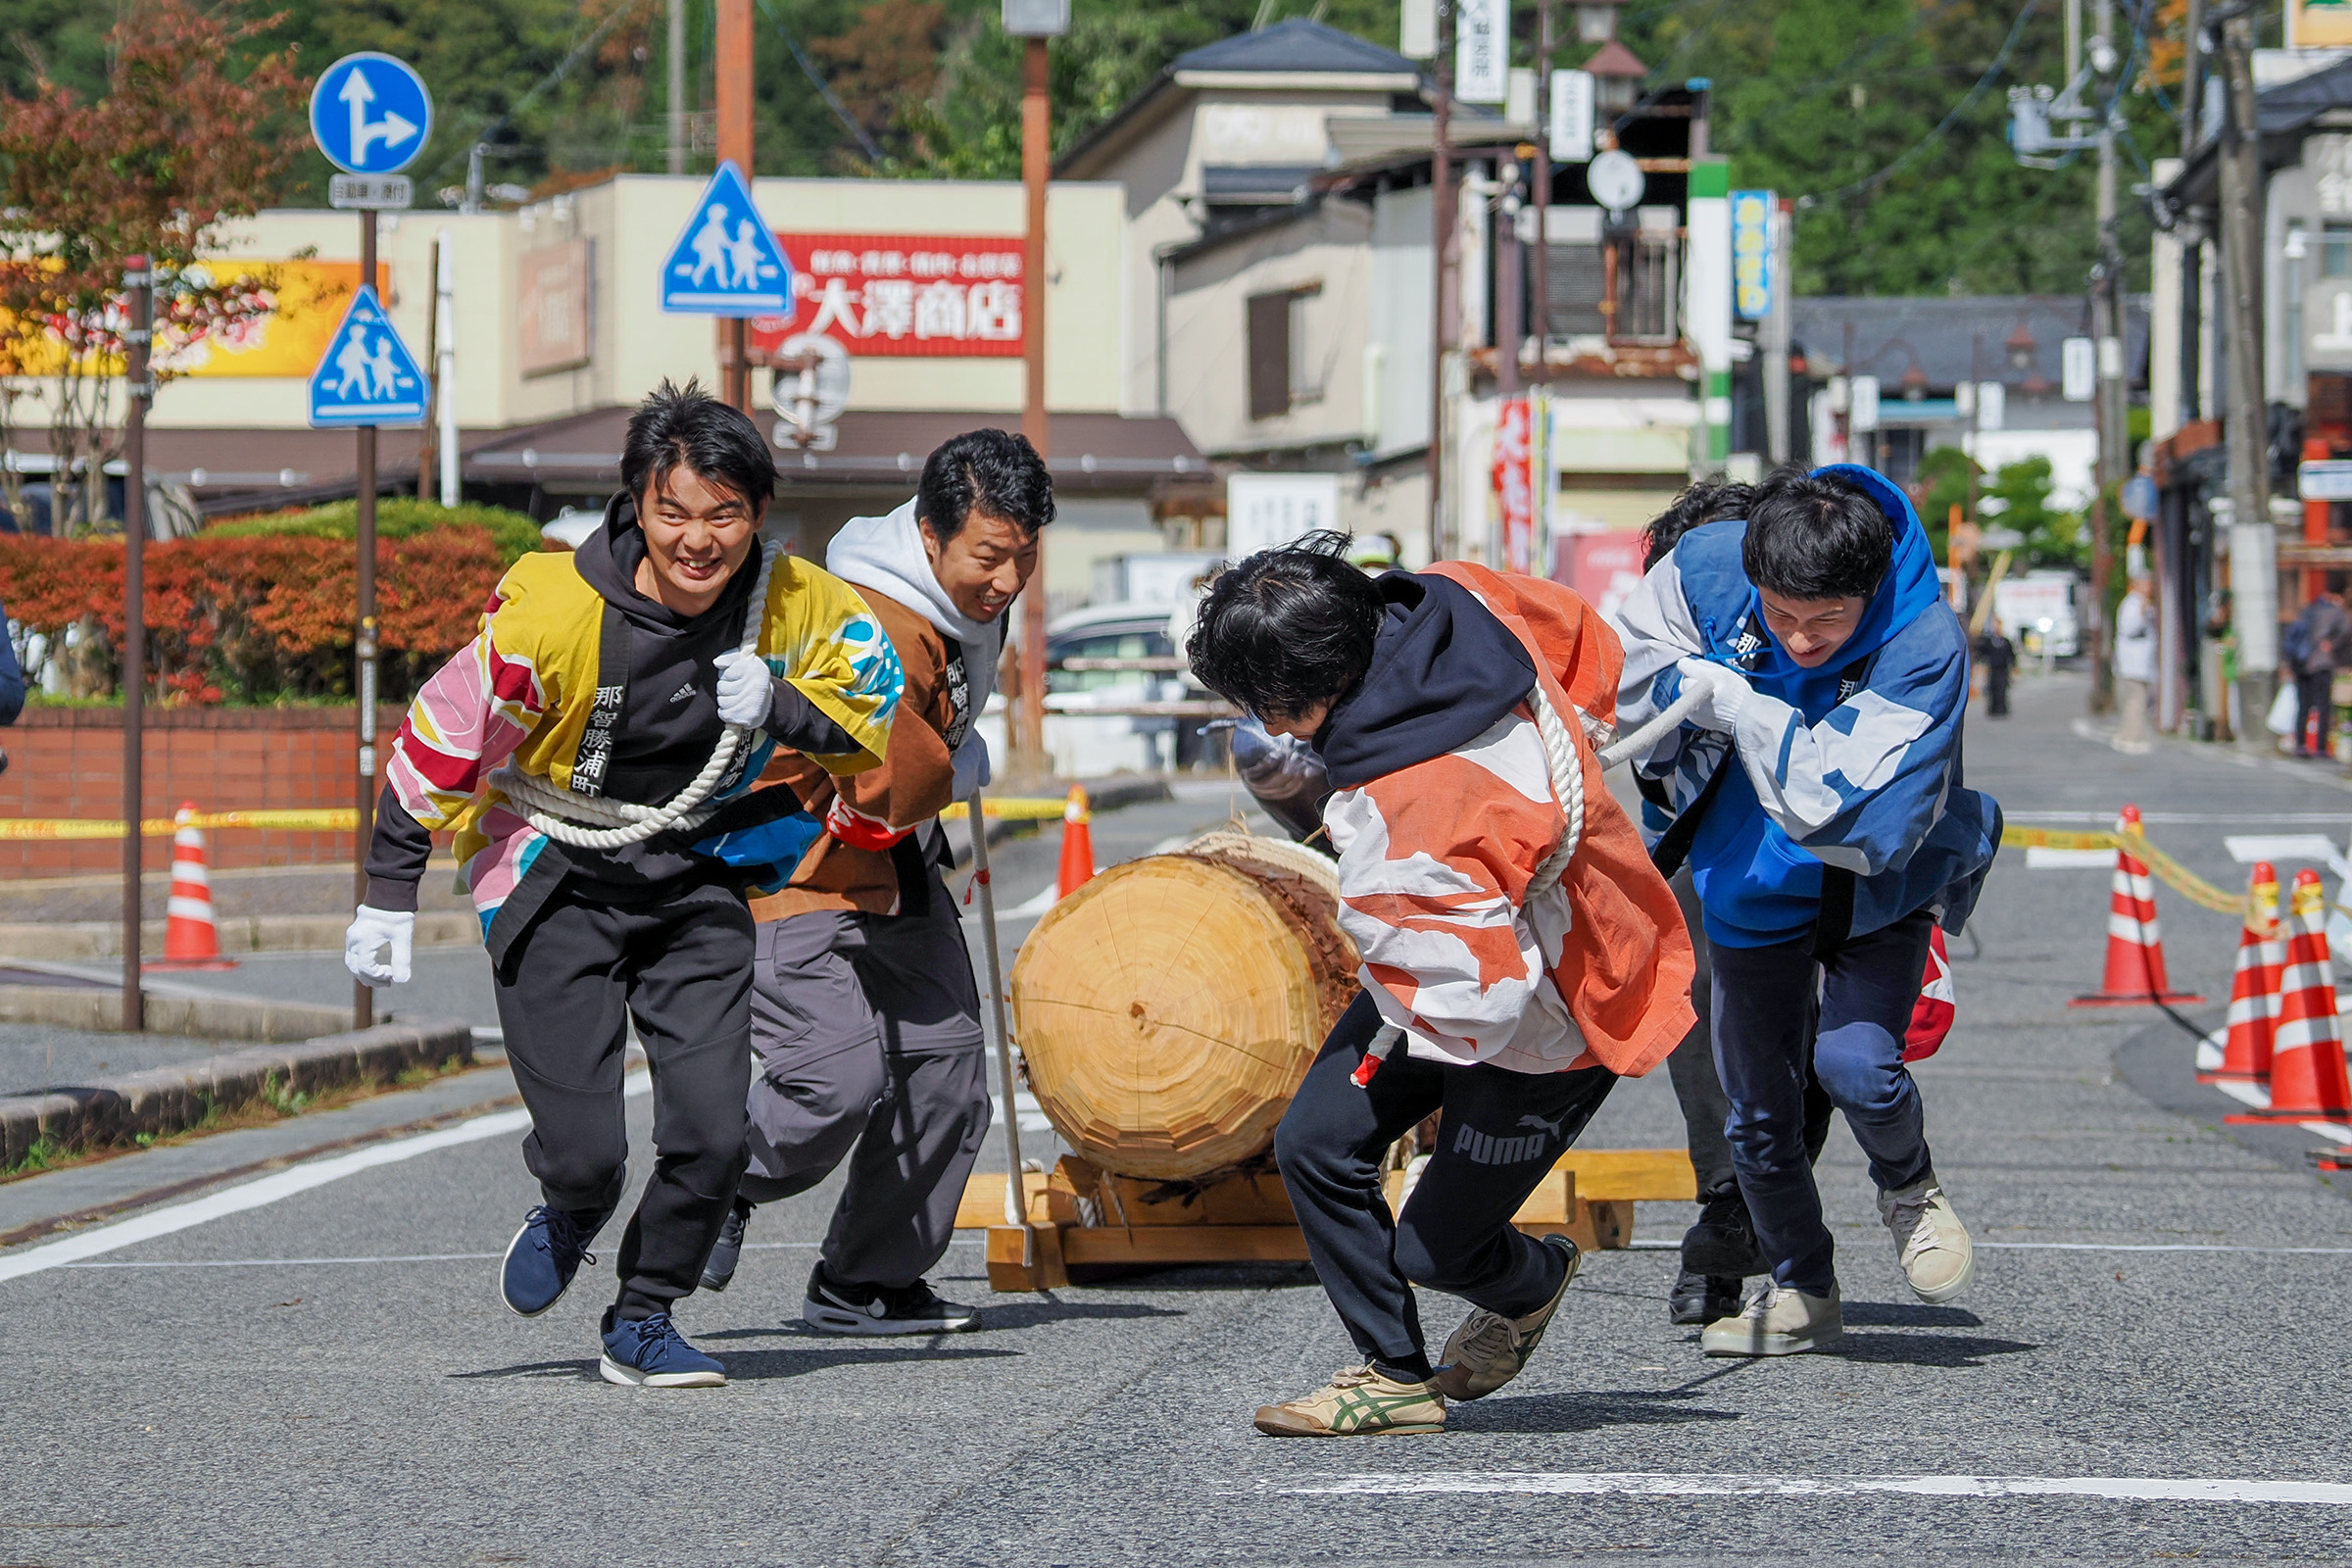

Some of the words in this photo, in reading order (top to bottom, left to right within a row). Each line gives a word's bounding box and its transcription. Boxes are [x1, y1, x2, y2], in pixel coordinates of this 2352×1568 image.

[808, 277, 1022, 340] 大澤商店
[571, 685, 624, 798] 那智勝浦町
[1452, 1123, 1545, 1165] PUMA
